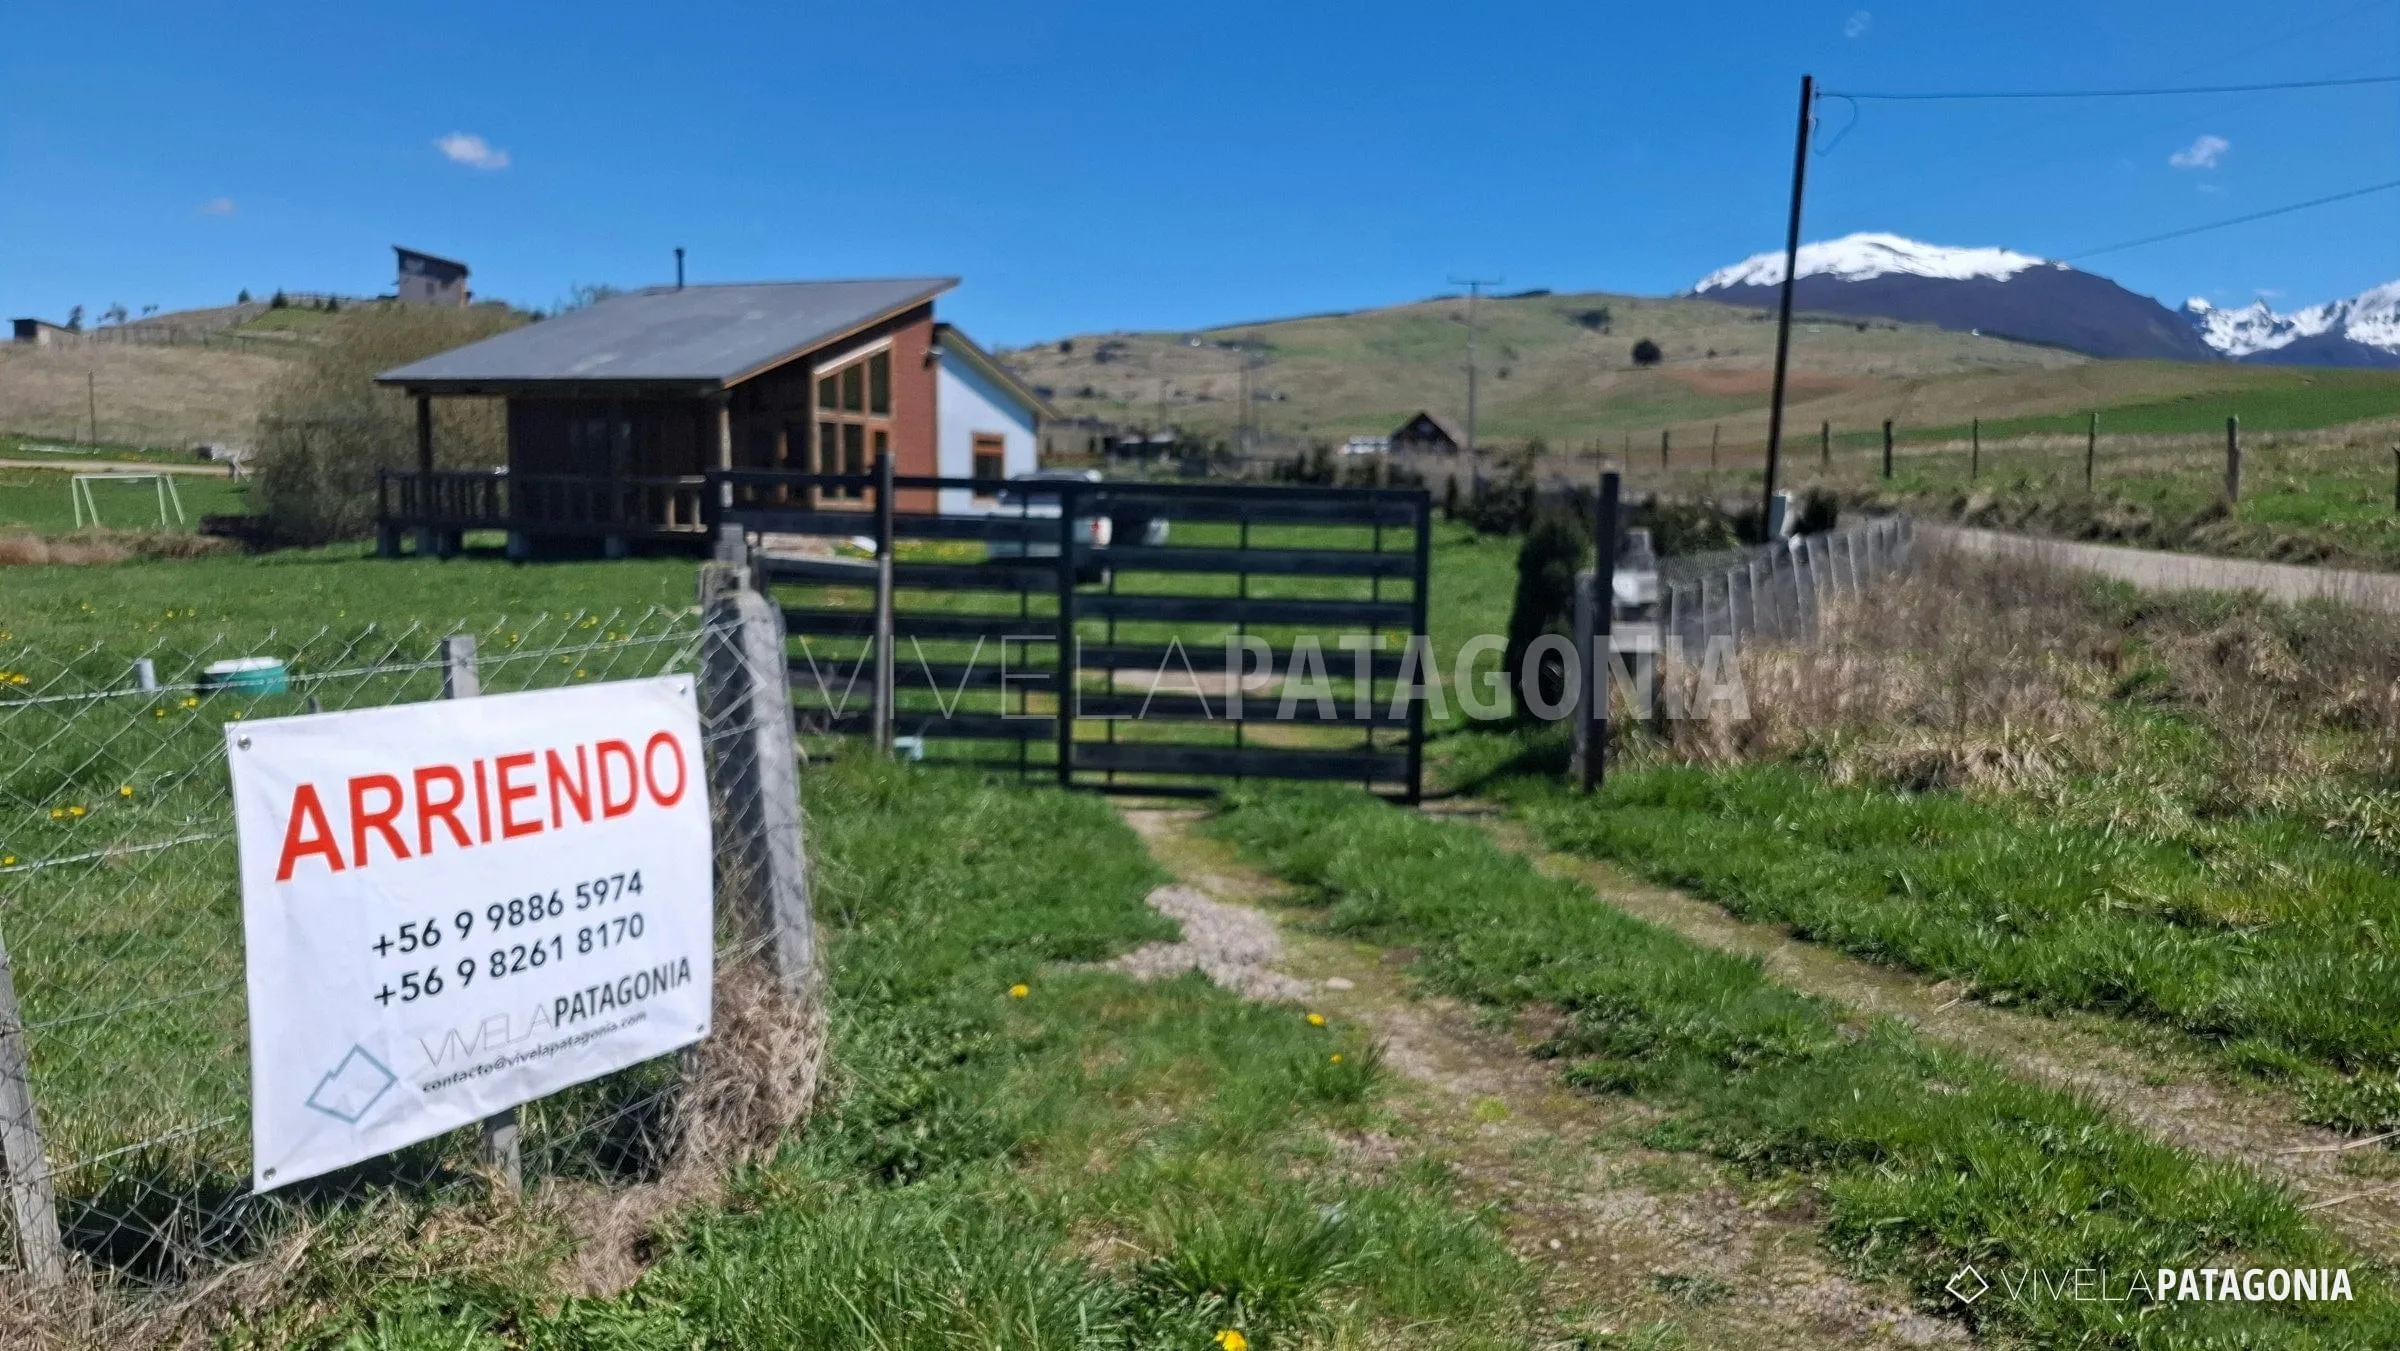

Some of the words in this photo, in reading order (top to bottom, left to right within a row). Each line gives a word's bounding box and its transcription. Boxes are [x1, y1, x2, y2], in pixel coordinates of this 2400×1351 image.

[275, 729, 687, 882] ARRIENDO
[372, 918, 442, 959] +56
[454, 910, 475, 941] 9
[486, 888, 565, 934] 9886
[576, 868, 645, 910] 5974
[373, 966, 444, 1007] +56
[457, 958, 476, 988] 9
[489, 933, 564, 979] 8261
[577, 912, 645, 955] 8170
[422, 1010, 648, 1094] contacto@vivelapatagonia.com
